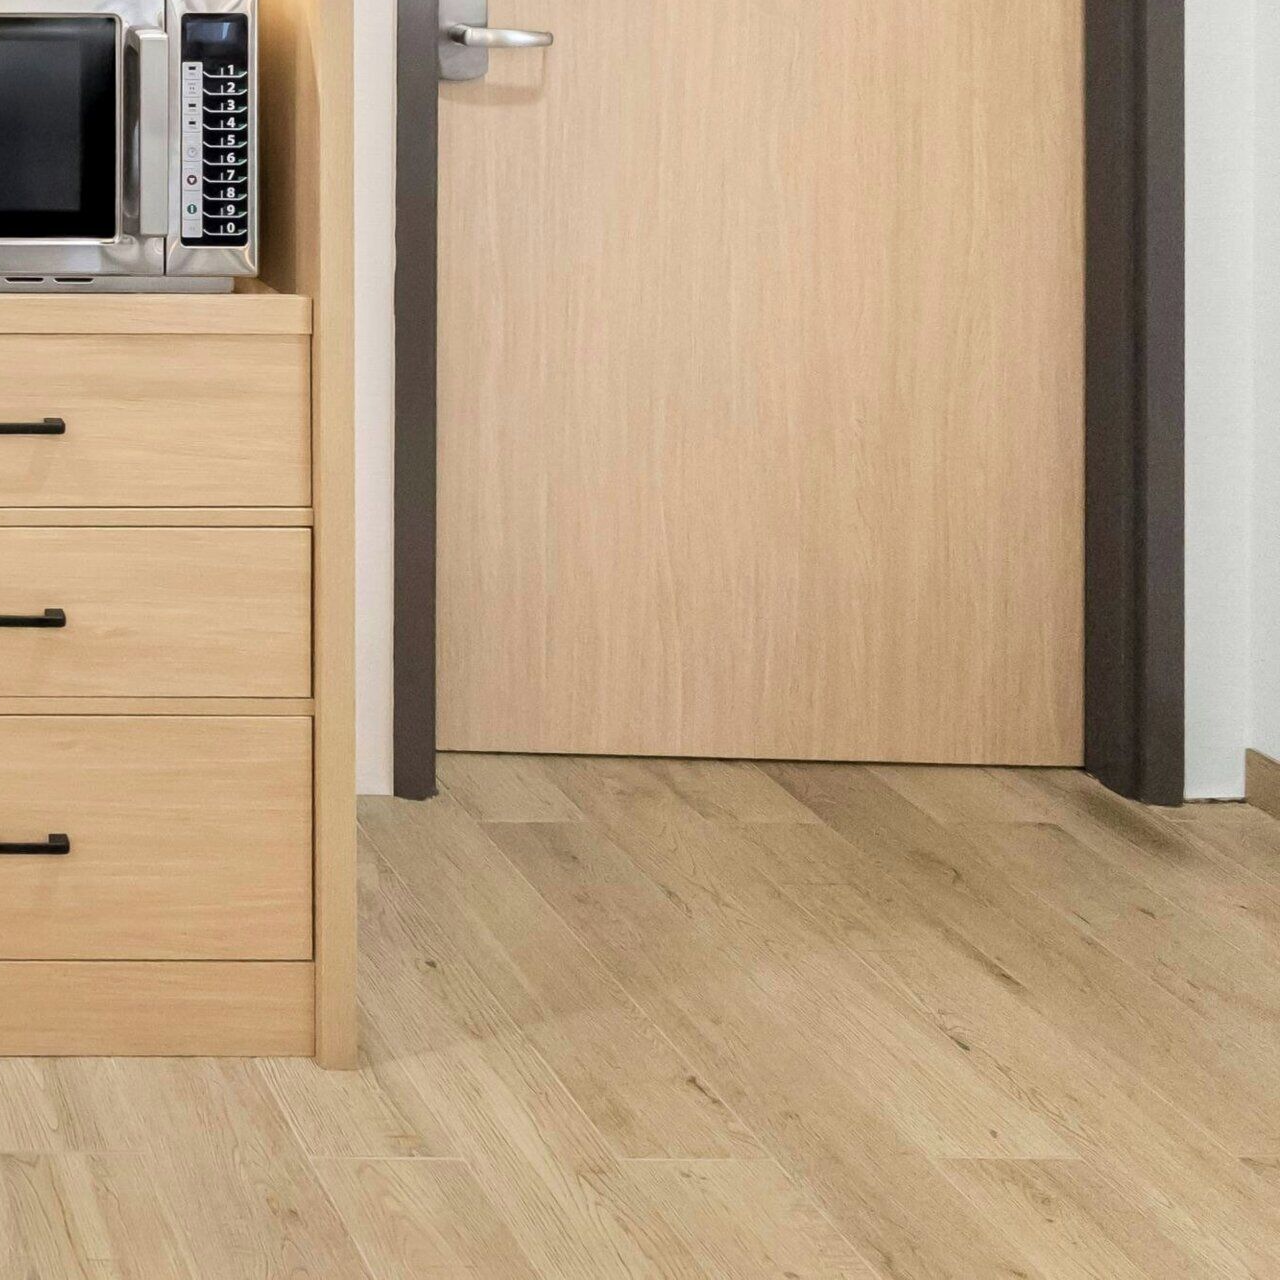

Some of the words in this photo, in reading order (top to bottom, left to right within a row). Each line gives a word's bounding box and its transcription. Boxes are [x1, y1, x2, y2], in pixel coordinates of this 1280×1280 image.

[227, 65, 235, 75] 1
[227, 82, 235, 93] 2
[227, 100, 235, 110] 3
[227, 117, 235, 128] 4
[227, 135, 235, 146] 5
[227, 152, 235, 163] 6
[227, 170, 235, 180] 7
[227, 187, 235, 198] 8
[227, 205, 235, 215] 9
[227, 222, 235, 233] 0
